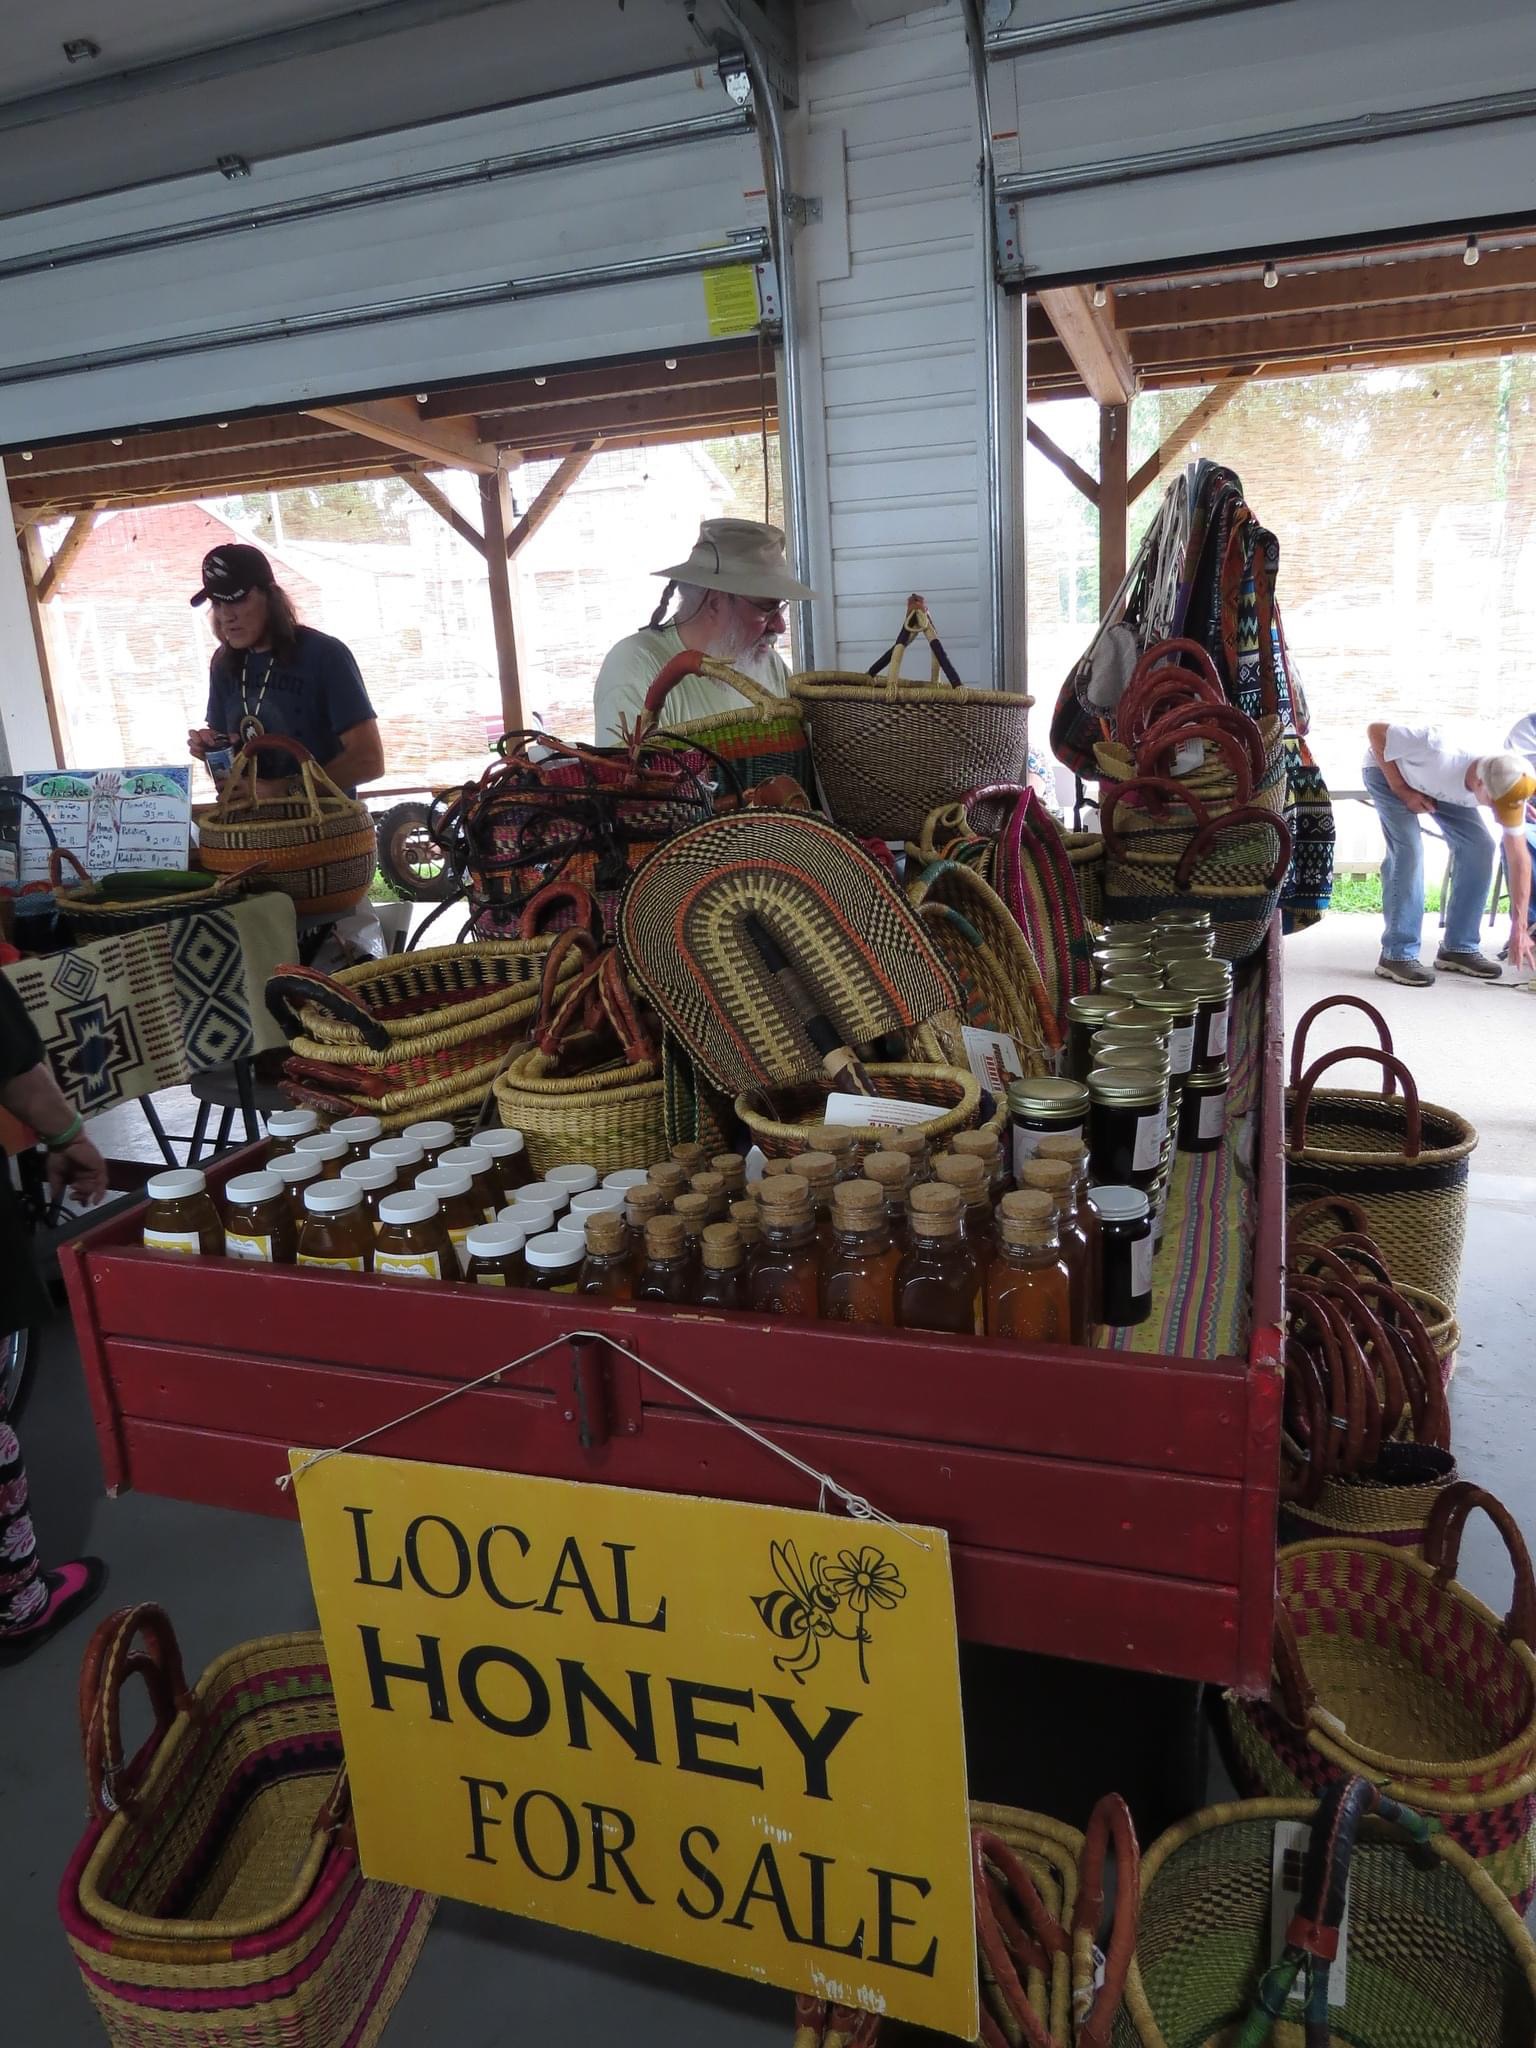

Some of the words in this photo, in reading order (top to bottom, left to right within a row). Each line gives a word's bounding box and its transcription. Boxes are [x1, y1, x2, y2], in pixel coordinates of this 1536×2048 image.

[344, 1507, 666, 1632] LOCAL
[358, 1625, 862, 1800] HONEY
[461, 1776, 655, 1905] FOR
[677, 1825, 937, 1977] SALE
